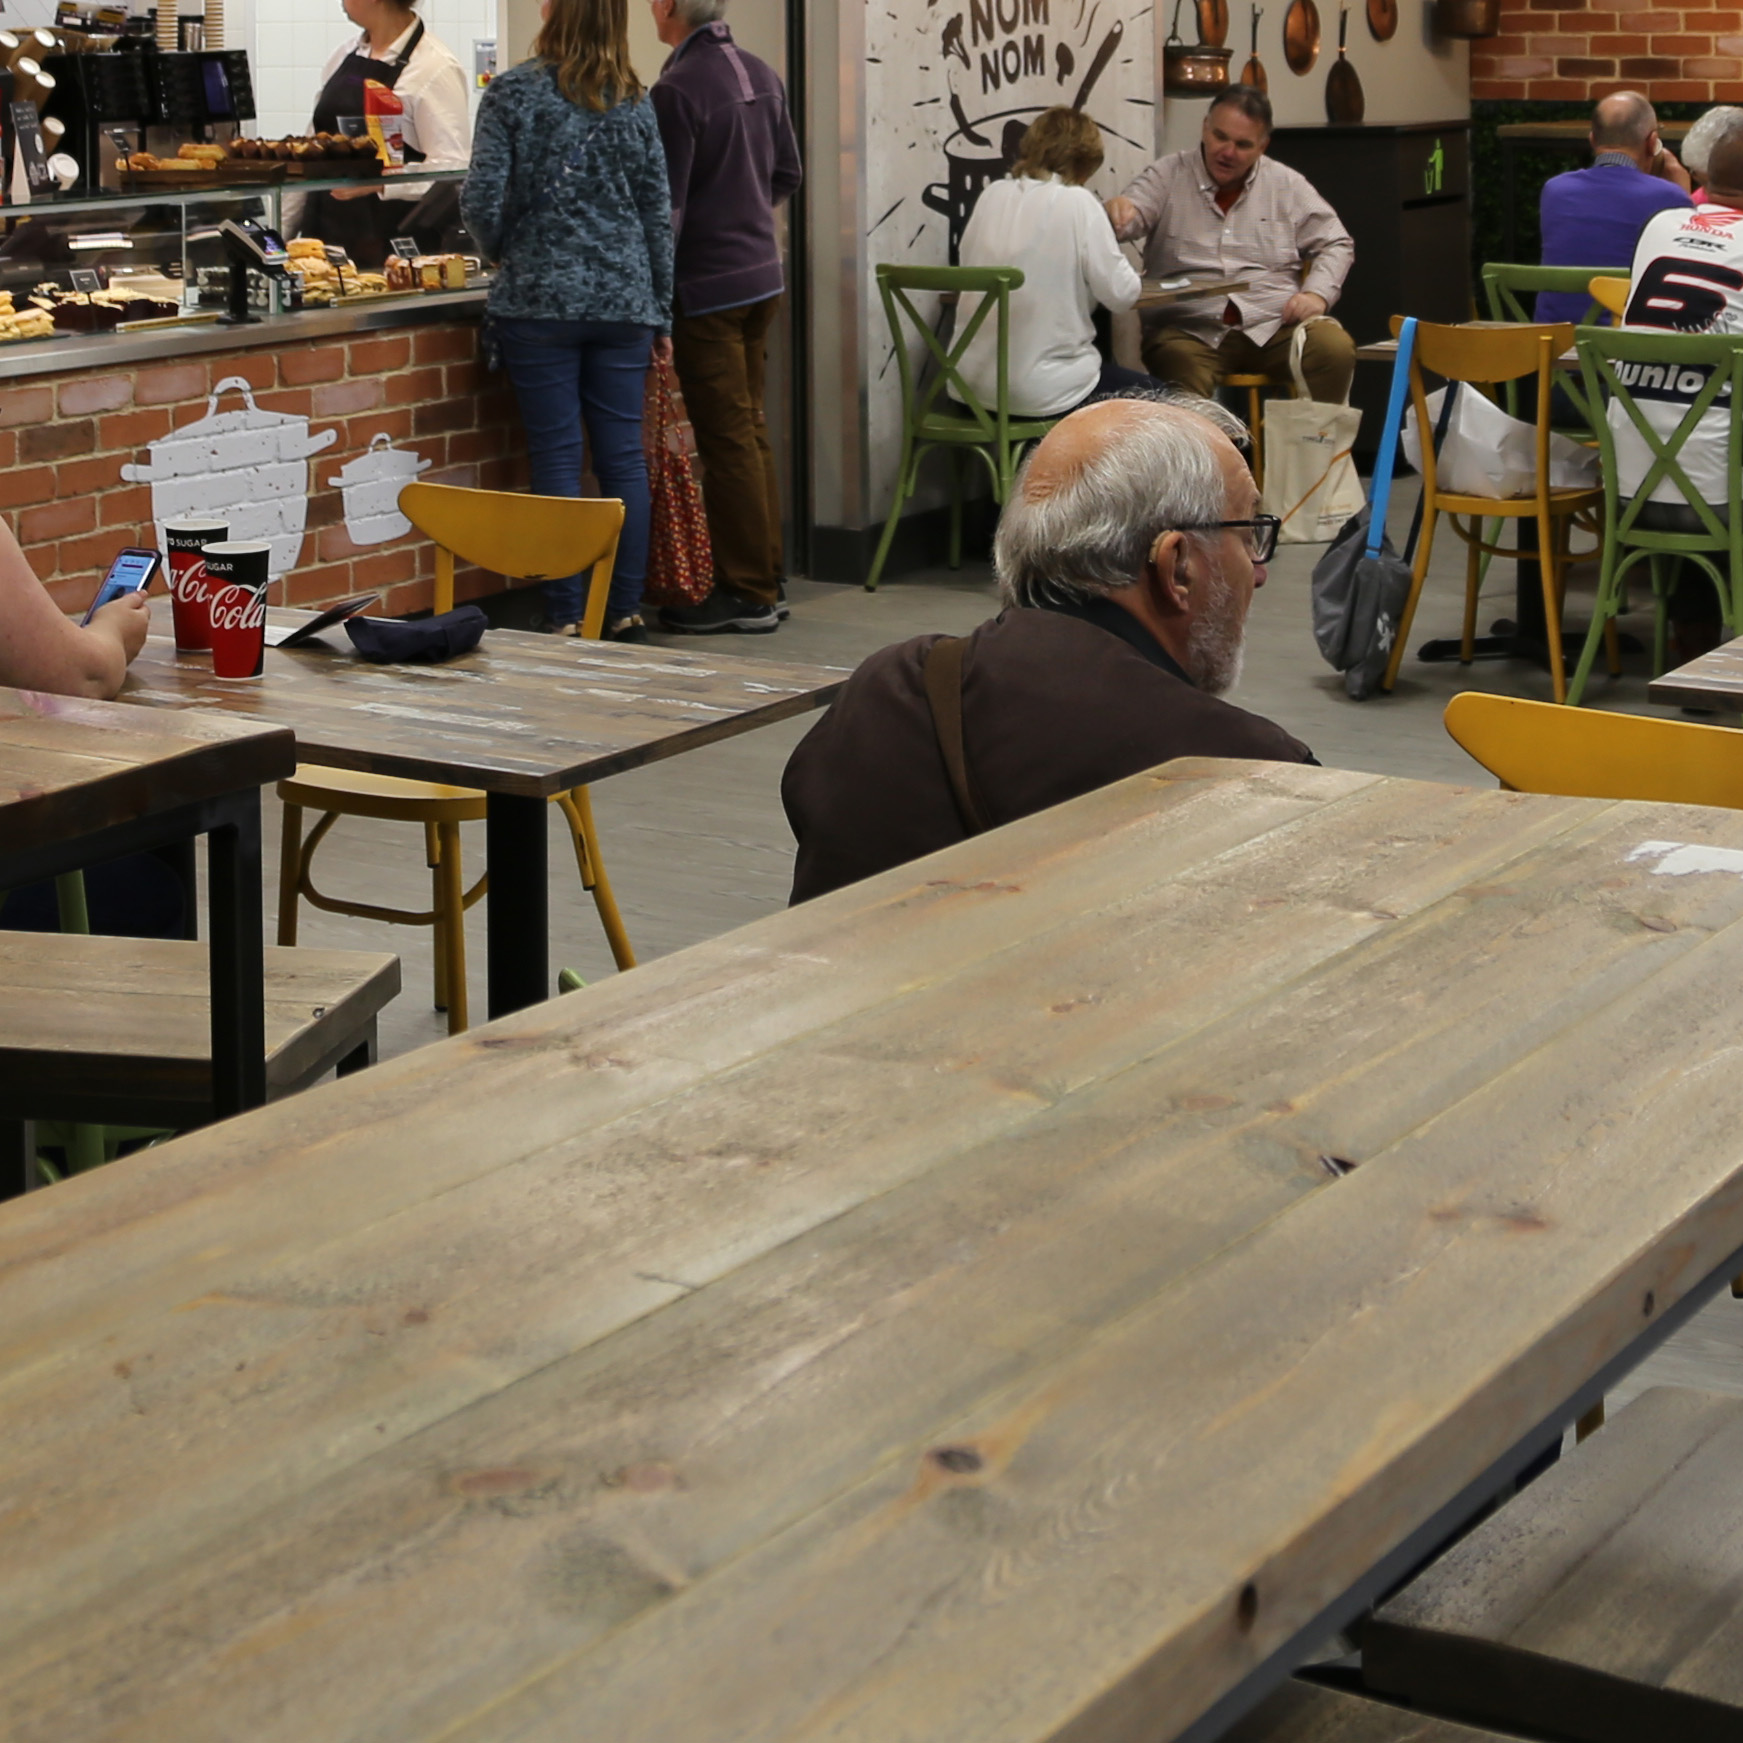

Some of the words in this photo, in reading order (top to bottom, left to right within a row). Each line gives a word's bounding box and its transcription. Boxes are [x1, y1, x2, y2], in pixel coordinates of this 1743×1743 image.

[981, 34, 1045, 95] NOM
[1680, 224, 1734, 240] HONDA
[176, 538, 207, 548] SUGAR
